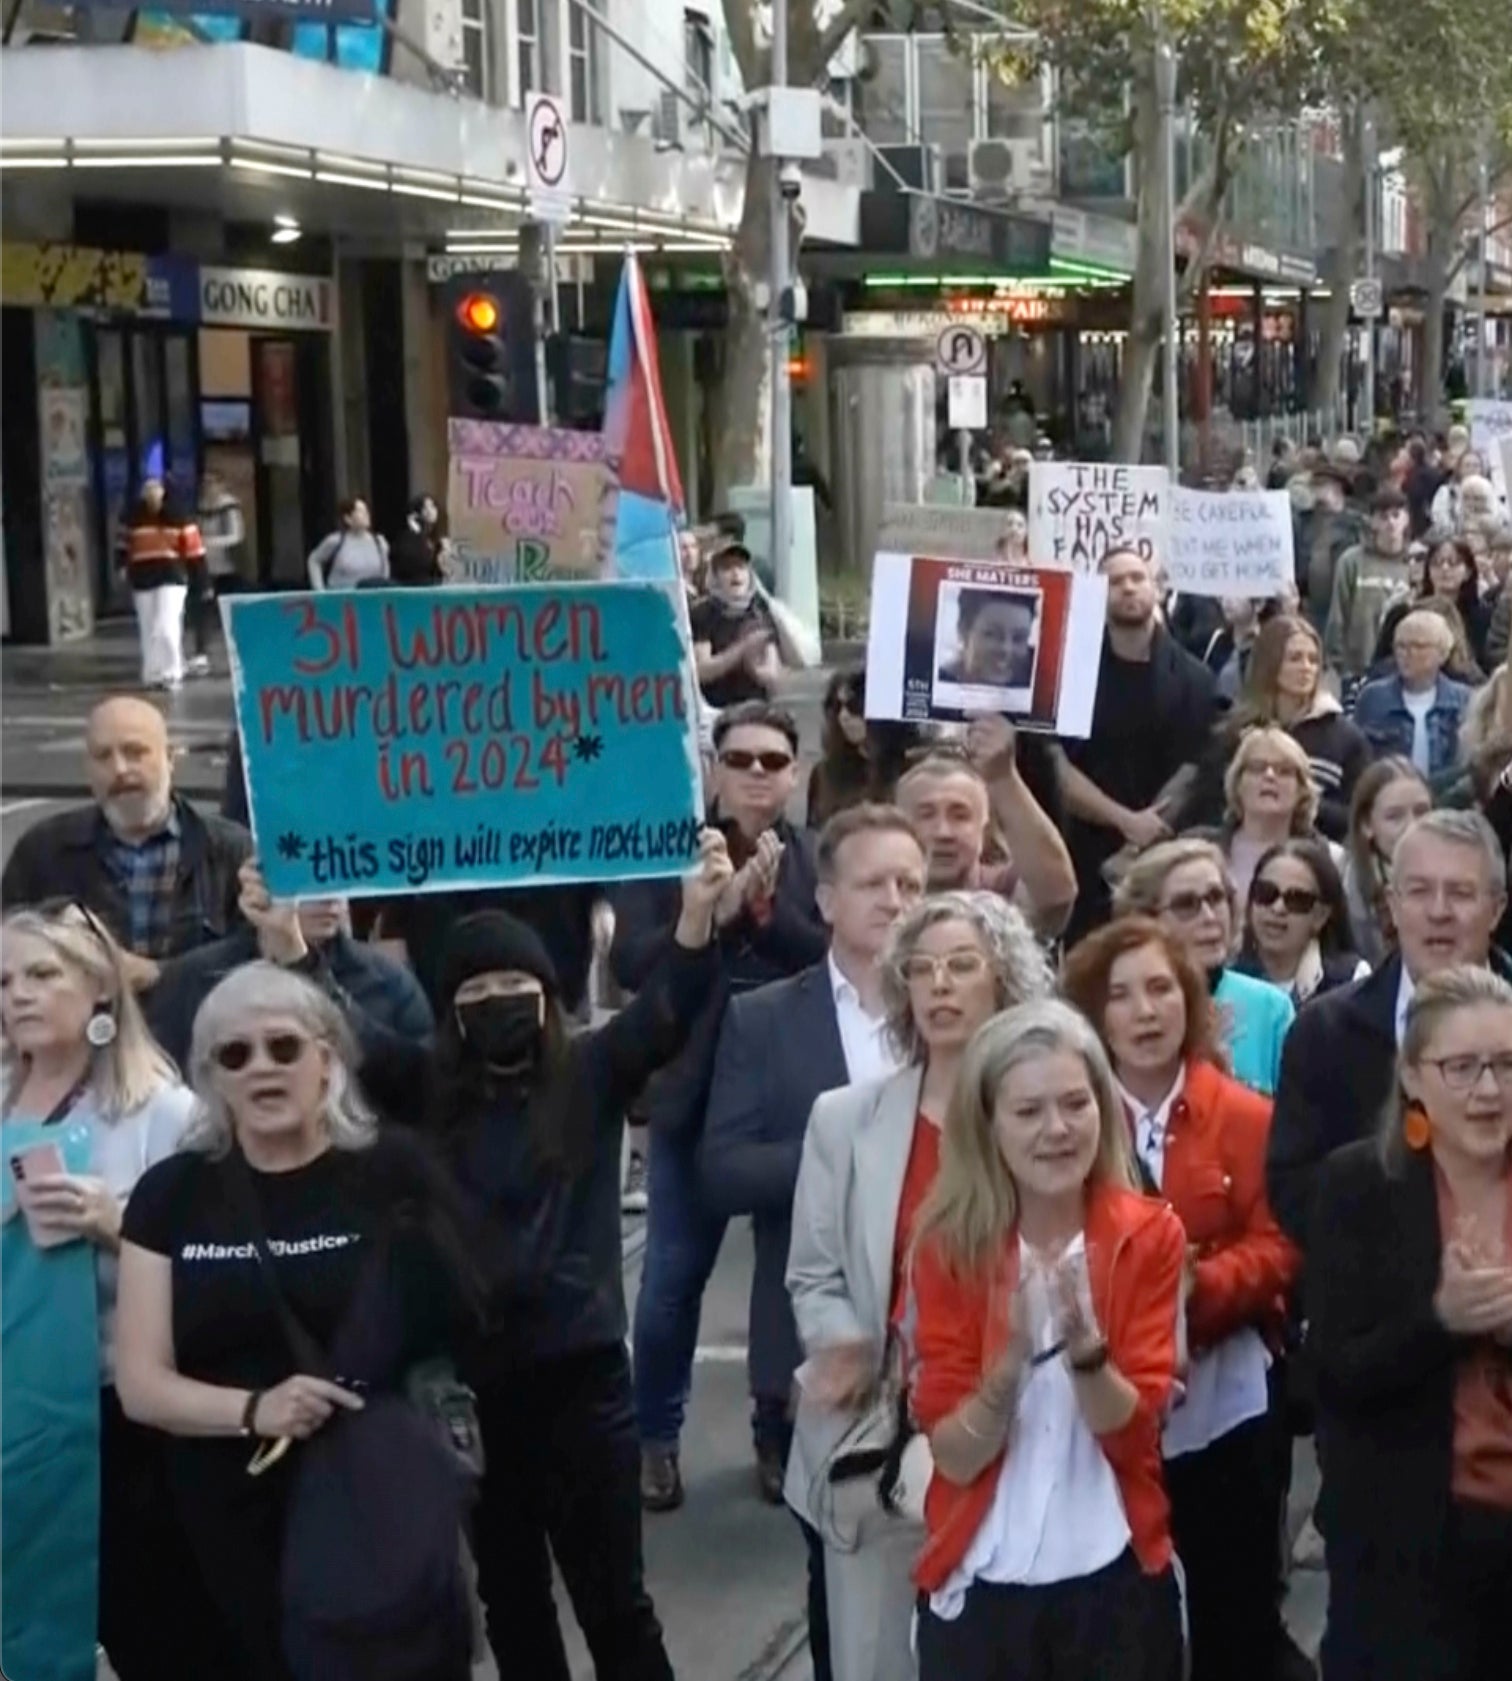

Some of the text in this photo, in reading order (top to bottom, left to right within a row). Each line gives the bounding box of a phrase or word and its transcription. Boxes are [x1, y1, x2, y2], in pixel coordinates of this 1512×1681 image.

[203, 278, 268, 318] GONG
[273, 283, 317, 322] CHA
[457, 459, 574, 512] Teach
[1067, 464, 1128, 490] THE
[1047, 488, 1160, 519] SYSTEM
[1075, 514, 1124, 540] HAS
[947, 566, 1040, 586] SHE MATTERS
[1200, 559, 1230, 581] GET
[287, 600, 361, 674] 31
[259, 671, 687, 746] murdered by men
[377, 735, 435, 800] in
[387, 829, 446, 886] sign
[453, 824, 500, 868] will
[509, 818, 582, 875] expire
